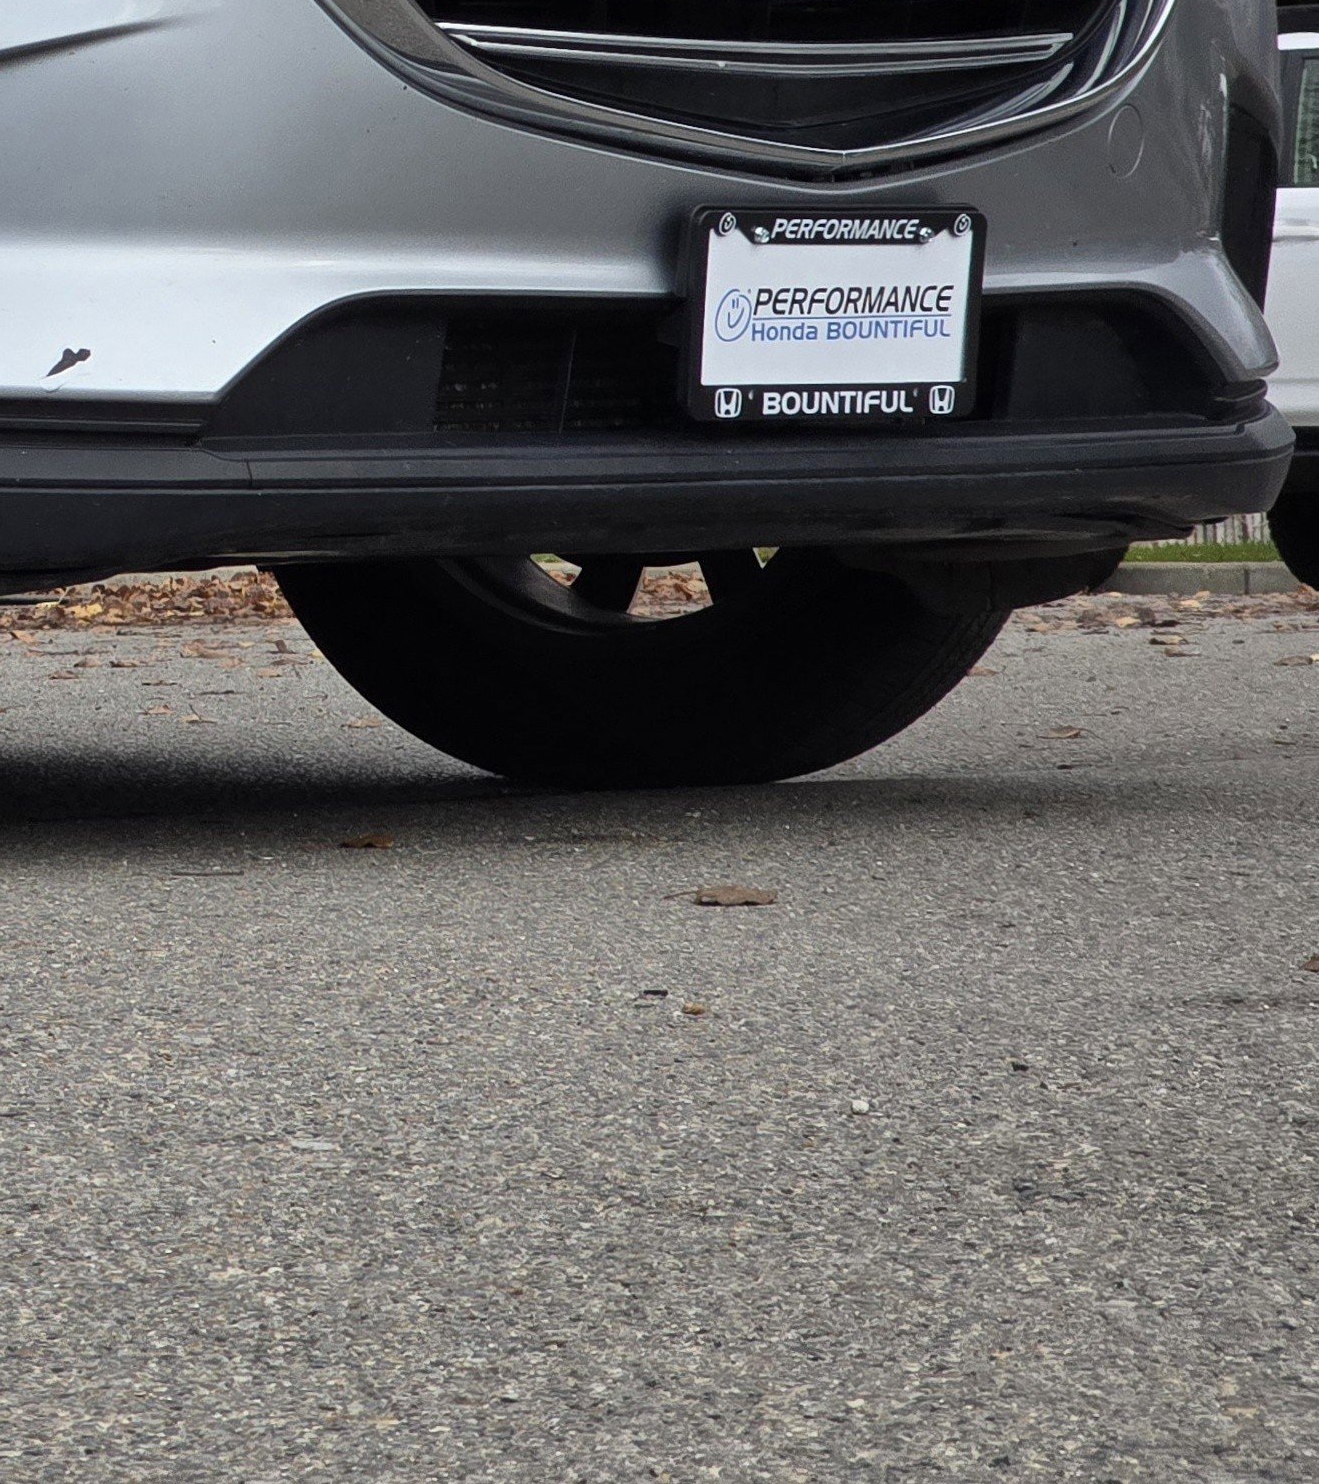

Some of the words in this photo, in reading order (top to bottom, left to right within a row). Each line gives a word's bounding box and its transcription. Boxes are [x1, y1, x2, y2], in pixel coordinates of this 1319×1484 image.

[770, 218, 920, 240] PERFORMANCE
[753, 284, 955, 316] PERFORMANCE
[751, 322, 818, 342] Honda
[826, 318, 952, 341] BOUNTIFUL
[762, 389, 914, 416] BOUNTIFUL
